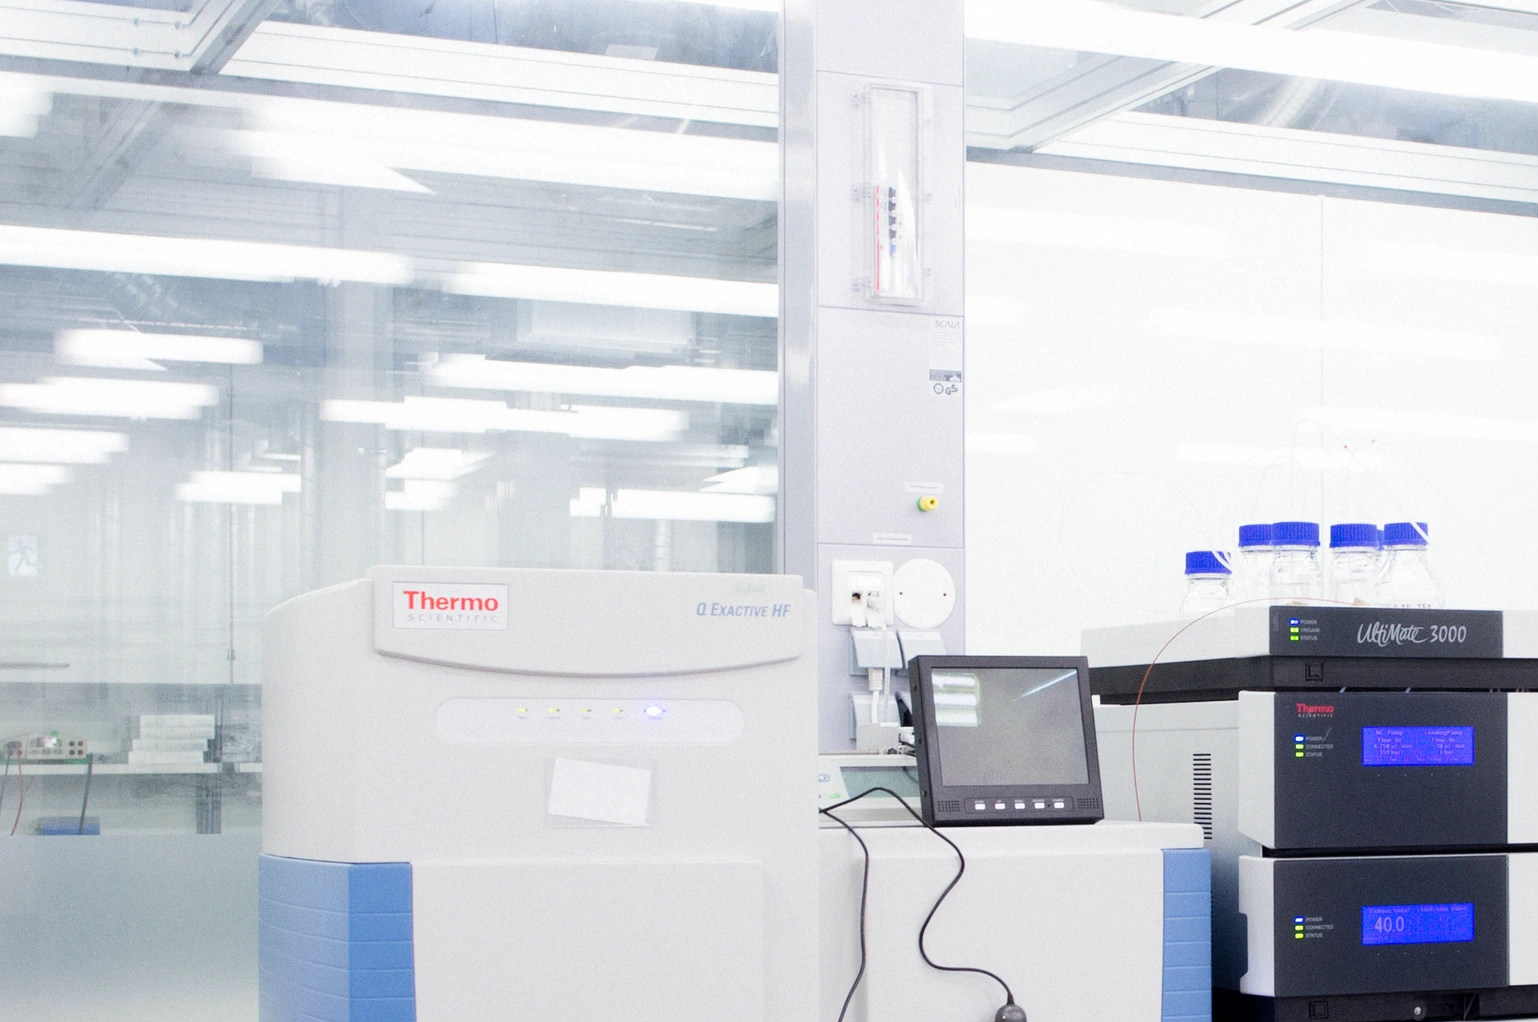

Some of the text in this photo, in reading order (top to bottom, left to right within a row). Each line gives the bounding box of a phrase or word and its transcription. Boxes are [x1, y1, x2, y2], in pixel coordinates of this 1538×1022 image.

[403, 590, 499, 612] Thermo
[407, 613, 498, 623] SCIENTIFIC
[696, 602, 707, 617] Q
[771, 603, 791, 618] HF
[1357, 621, 1467, 648] UltiMate 3000
[1296, 703, 1335, 713] Thermo
[1374, 916, 1405, 933] 40.0
